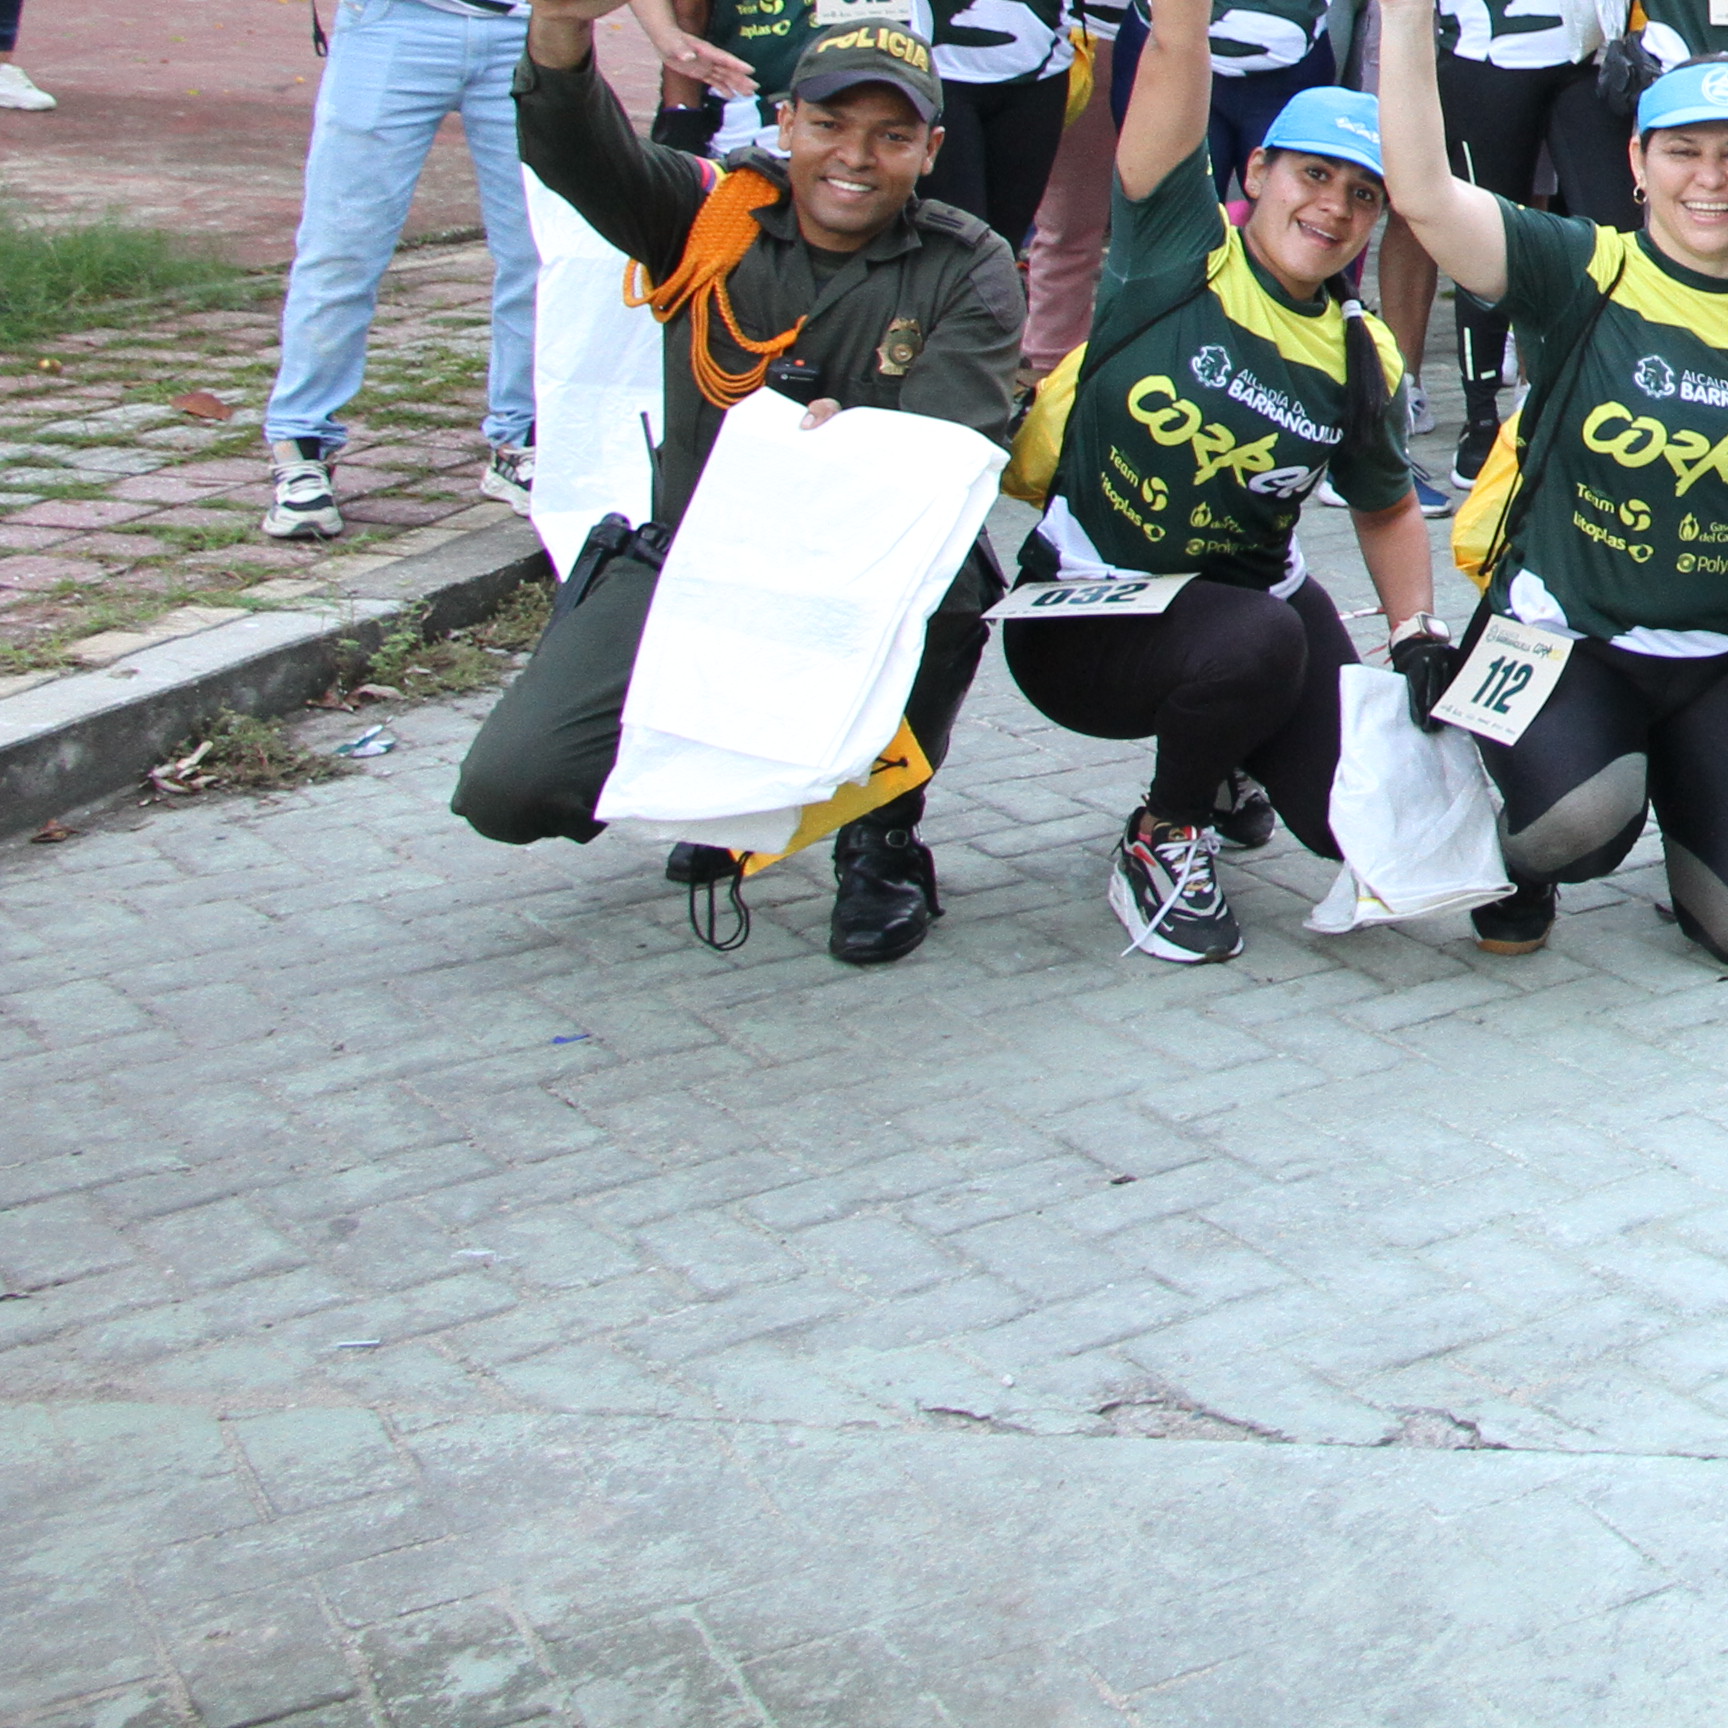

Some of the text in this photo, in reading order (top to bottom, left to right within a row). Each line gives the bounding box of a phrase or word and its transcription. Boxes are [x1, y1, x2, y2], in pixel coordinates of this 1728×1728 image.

[817, 26, 929, 72] POLICIA
[1108, 444, 1140, 488] Team
[1576, 481, 1616, 515] Team
[1572, 510, 1627, 552] litoplas
[1031, 582, 1151, 608] 032
[1470, 655, 1534, 715] 112
